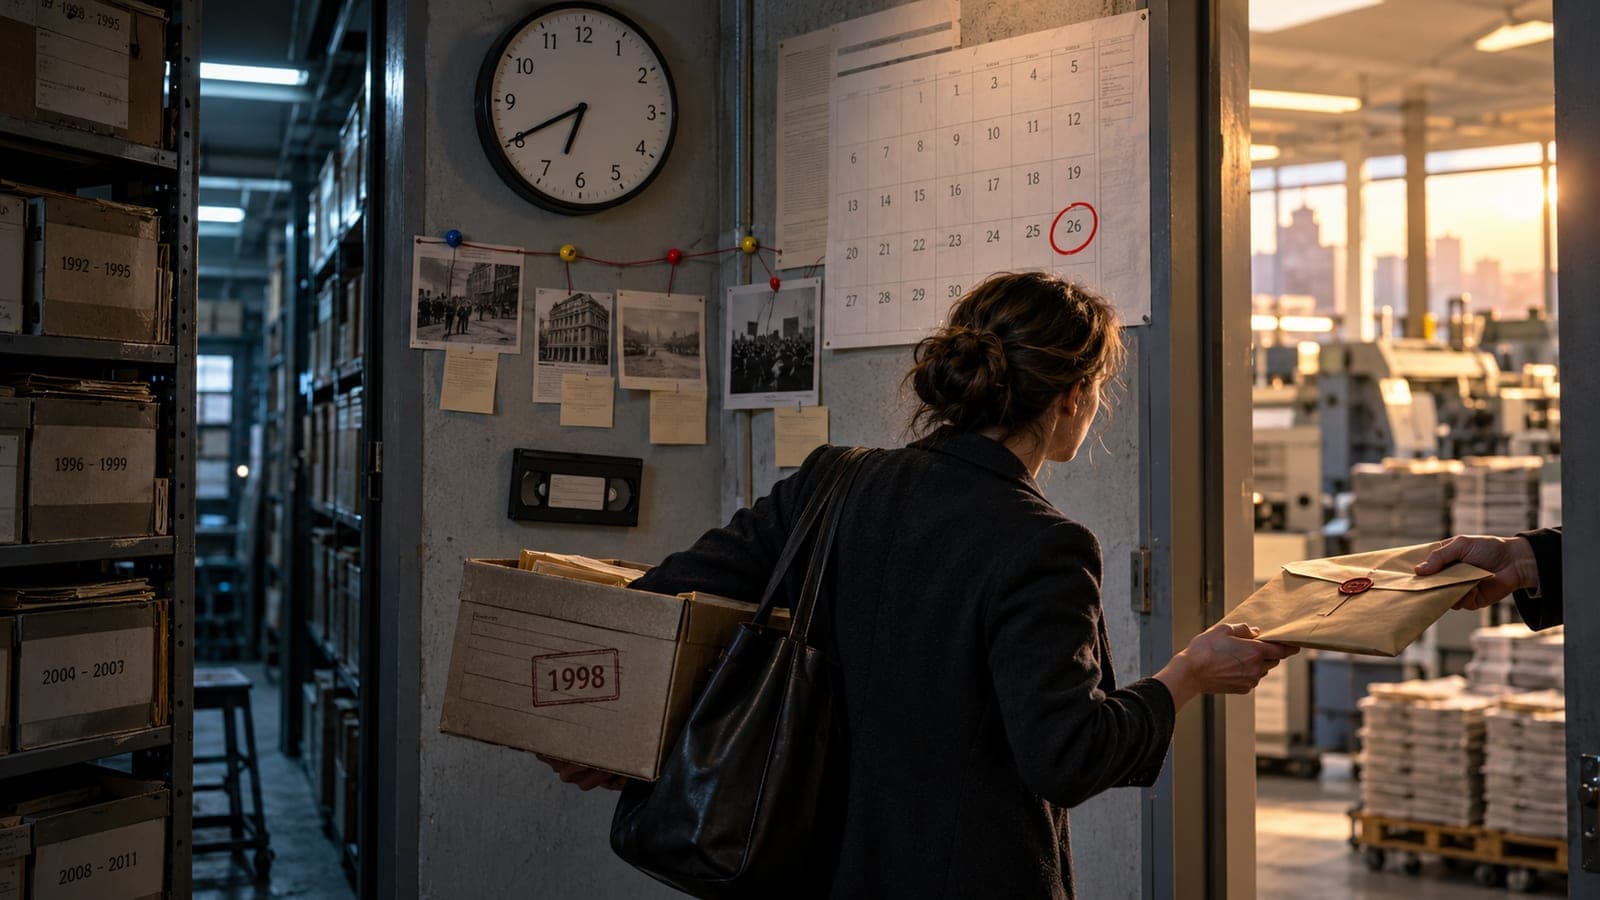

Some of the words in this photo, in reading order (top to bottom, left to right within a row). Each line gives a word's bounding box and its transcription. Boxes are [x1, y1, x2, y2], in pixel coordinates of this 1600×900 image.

[542, 31, 557, 50] 11
[575, 25, 593, 44] 12
[615, 39, 621, 57] 1
[515, 57, 534, 75] 10
[637, 66, 648, 84] 2
[990, 76, 998, 90] 3
[1029, 68, 1037, 81] 4
[1070, 59, 1078, 74] 5
[505, 93, 516, 111] 9
[646, 104, 657, 121] 3
[514, 131, 526, 149] 8
[850, 152, 857, 164] 6
[883, 145, 889, 159] 7
[917, 139, 924, 153] 8
[953, 133, 960, 146] 9
[987, 126, 1001, 141] 10
[1027, 119, 1039, 134] 11
[1068, 111, 1081, 127] 12
[635, 139, 646, 156] 4
[541, 159, 552, 177] 7
[611, 164, 621, 181] 5
[575, 171, 586, 189] 6
[847, 199, 858, 213] 13
[880, 194, 891, 208] 14
[914, 188, 926, 203] 15
[950, 183, 962, 197] 16
[988, 177, 1000, 192] 17
[1027, 171, 1040, 186] 18
[1068, 165, 1081, 180] 19
[846, 247, 858, 260] 20
[879, 243, 890, 256] 21
[912, 238, 926, 252] 22
[948, 233, 962, 248] 23
[986, 229, 1000, 243] 24
[1025, 224, 1041, 239] 25
[1066, 219, 1082, 234] 26
[61, 255, 90, 273] 1992
[104, 262, 131, 279] 1995
[845, 294, 858, 308] 27
[878, 291, 891, 304] 28
[912, 288, 926, 302] 29
[948, 284, 962, 298] 30
[55, 456, 84, 472] 1996
[100, 456, 128, 472] 1999
[92, 659, 125, 678] 2003
[547, 664, 605, 693] 1998
[58, 863, 93, 886] 2008
[108, 851, 137, 872] 2011
